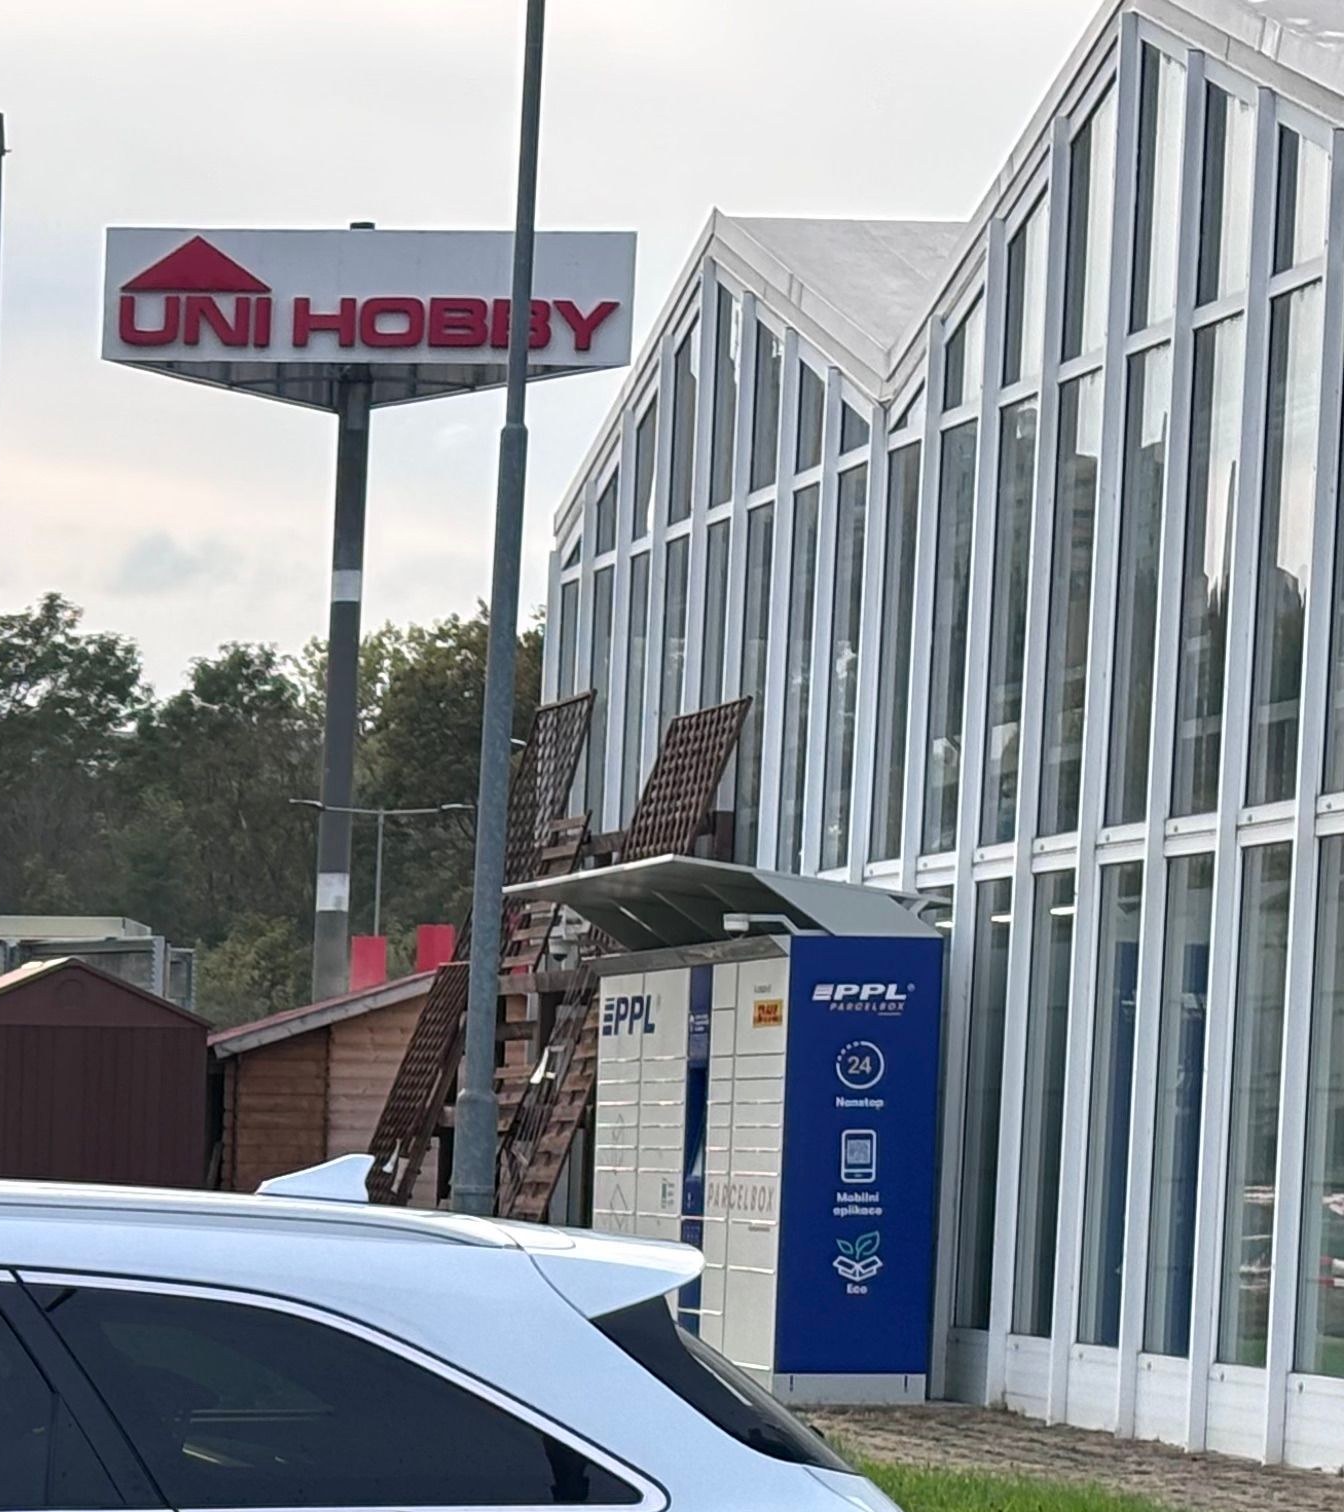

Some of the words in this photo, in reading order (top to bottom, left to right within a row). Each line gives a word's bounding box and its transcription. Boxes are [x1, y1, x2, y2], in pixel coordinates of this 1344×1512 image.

[118, 296, 272, 347] UNI
[292, 297, 620, 351] HOBBY
[834, 984, 906, 1000] PPL
[614, 994, 655, 1035] PPL
[829, 1002, 904, 1011] PARCELBOX
[847, 1056, 872, 1074] 24
[835, 1096, 884, 1111] Nonstop
[707, 1180, 775, 1212] PARCELBOX
[846, 1283, 868, 1295] Eco
